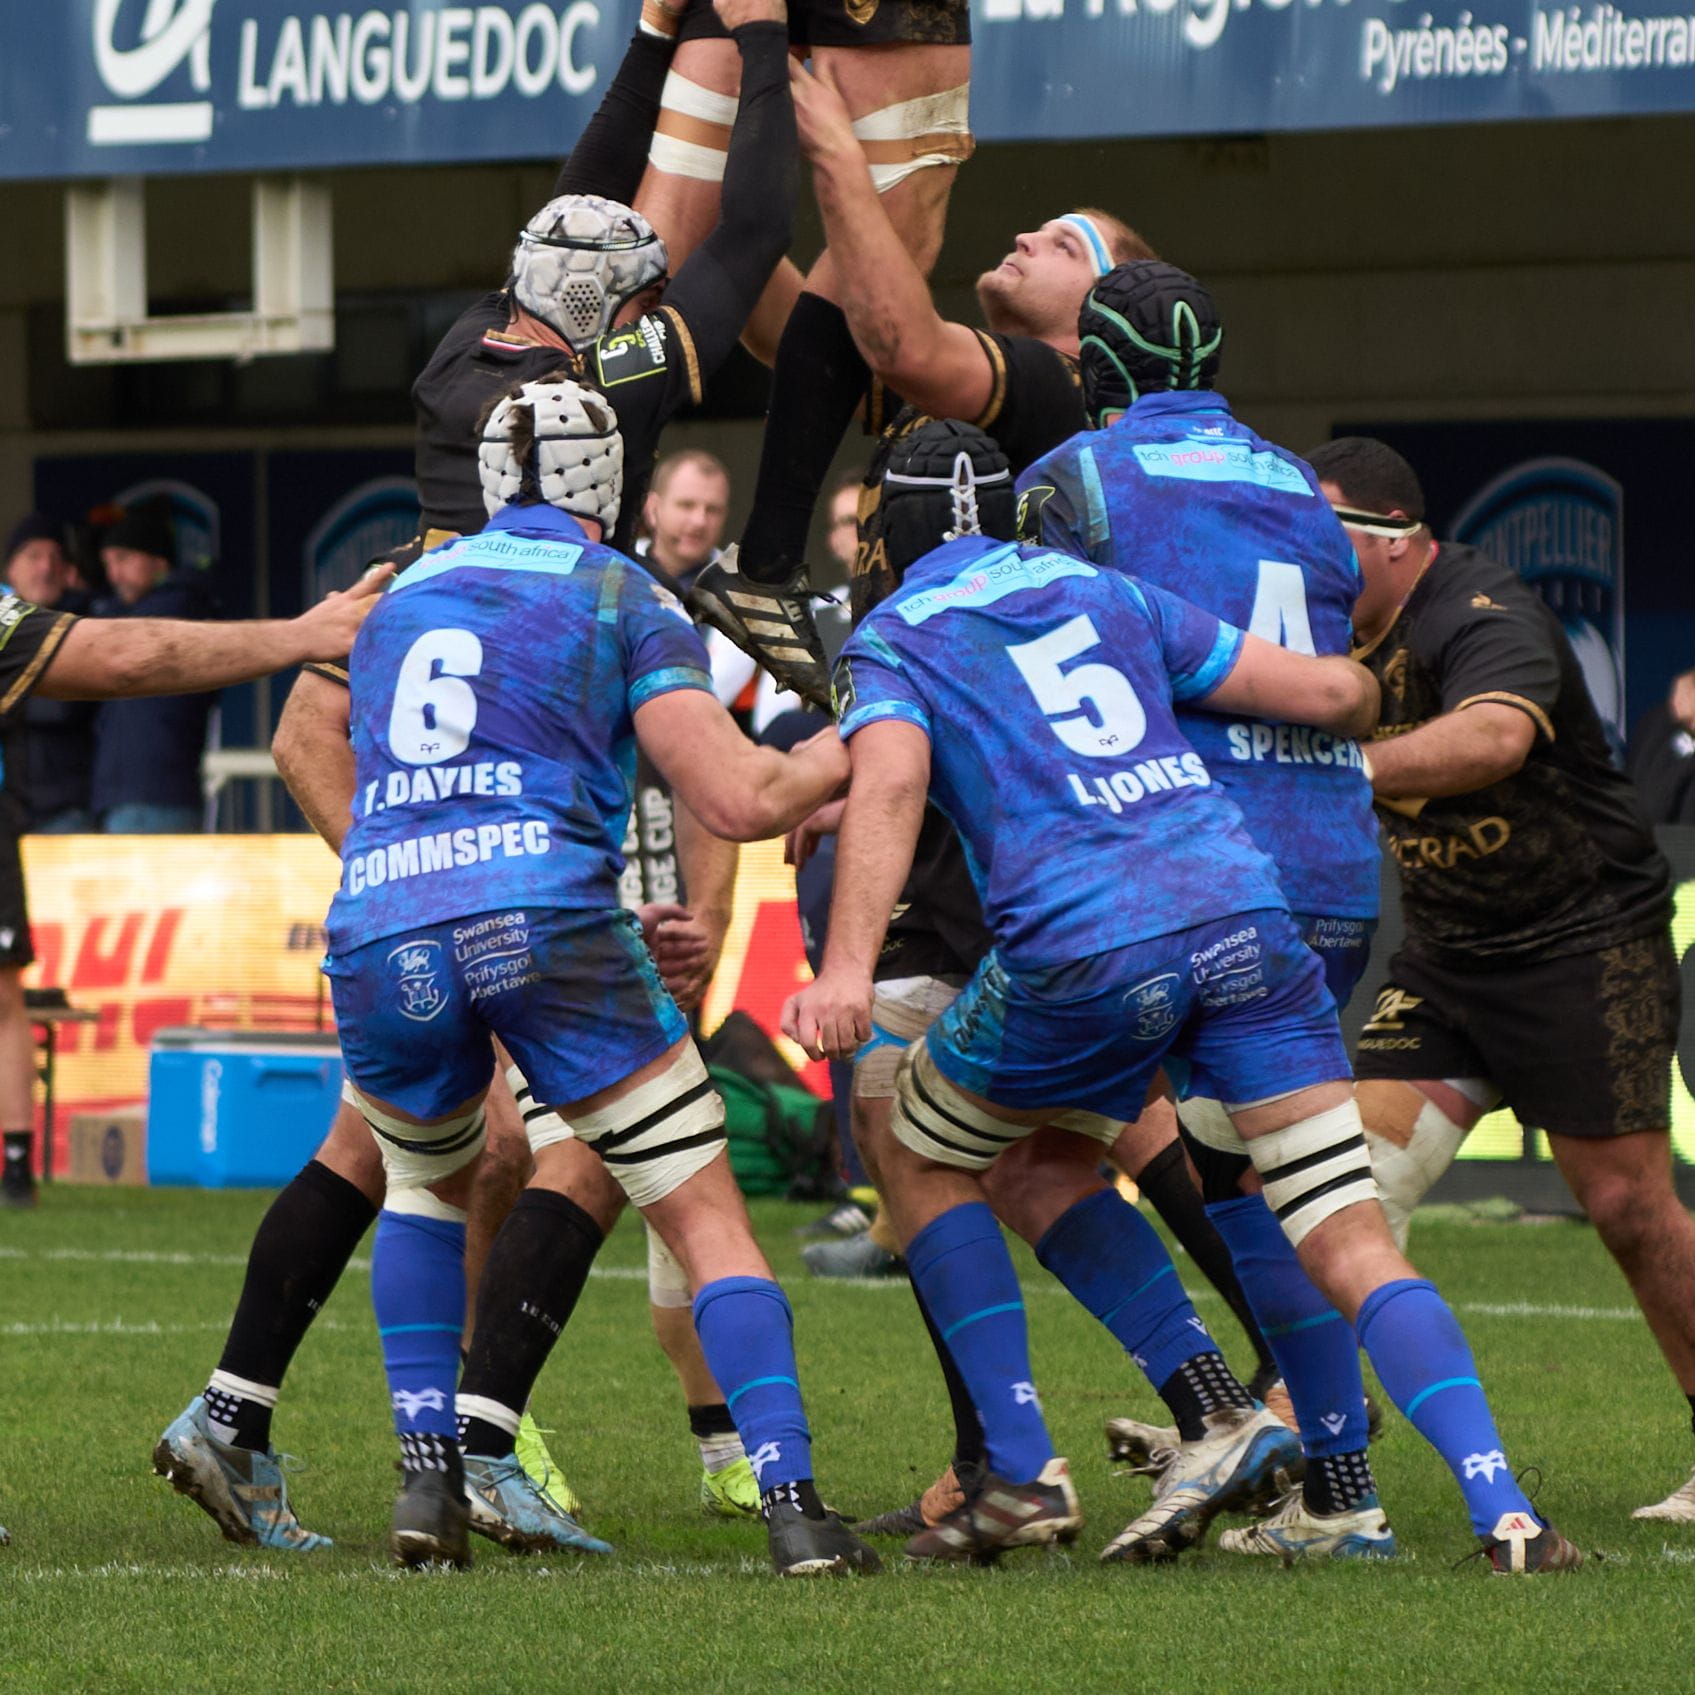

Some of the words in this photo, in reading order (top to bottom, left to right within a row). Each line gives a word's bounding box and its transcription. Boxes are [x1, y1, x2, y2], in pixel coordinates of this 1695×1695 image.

[238, 0, 601, 107] LANGUEDOC
[1360, 9, 1509, 94] Pyrénées
[467, 539, 518, 555] south
[519, 545, 570, 559] africa
[387, 628, 484, 766] 6
[1005, 615, 1148, 758] 5
[642, 785, 675, 854] CUP
[347, 820, 552, 898] COMMSPEC
[452, 911, 526, 945] Swansea
[455, 928, 530, 963] University
[1190, 926, 1258, 968] Swansea
[463, 953, 532, 987] Prifysgol
